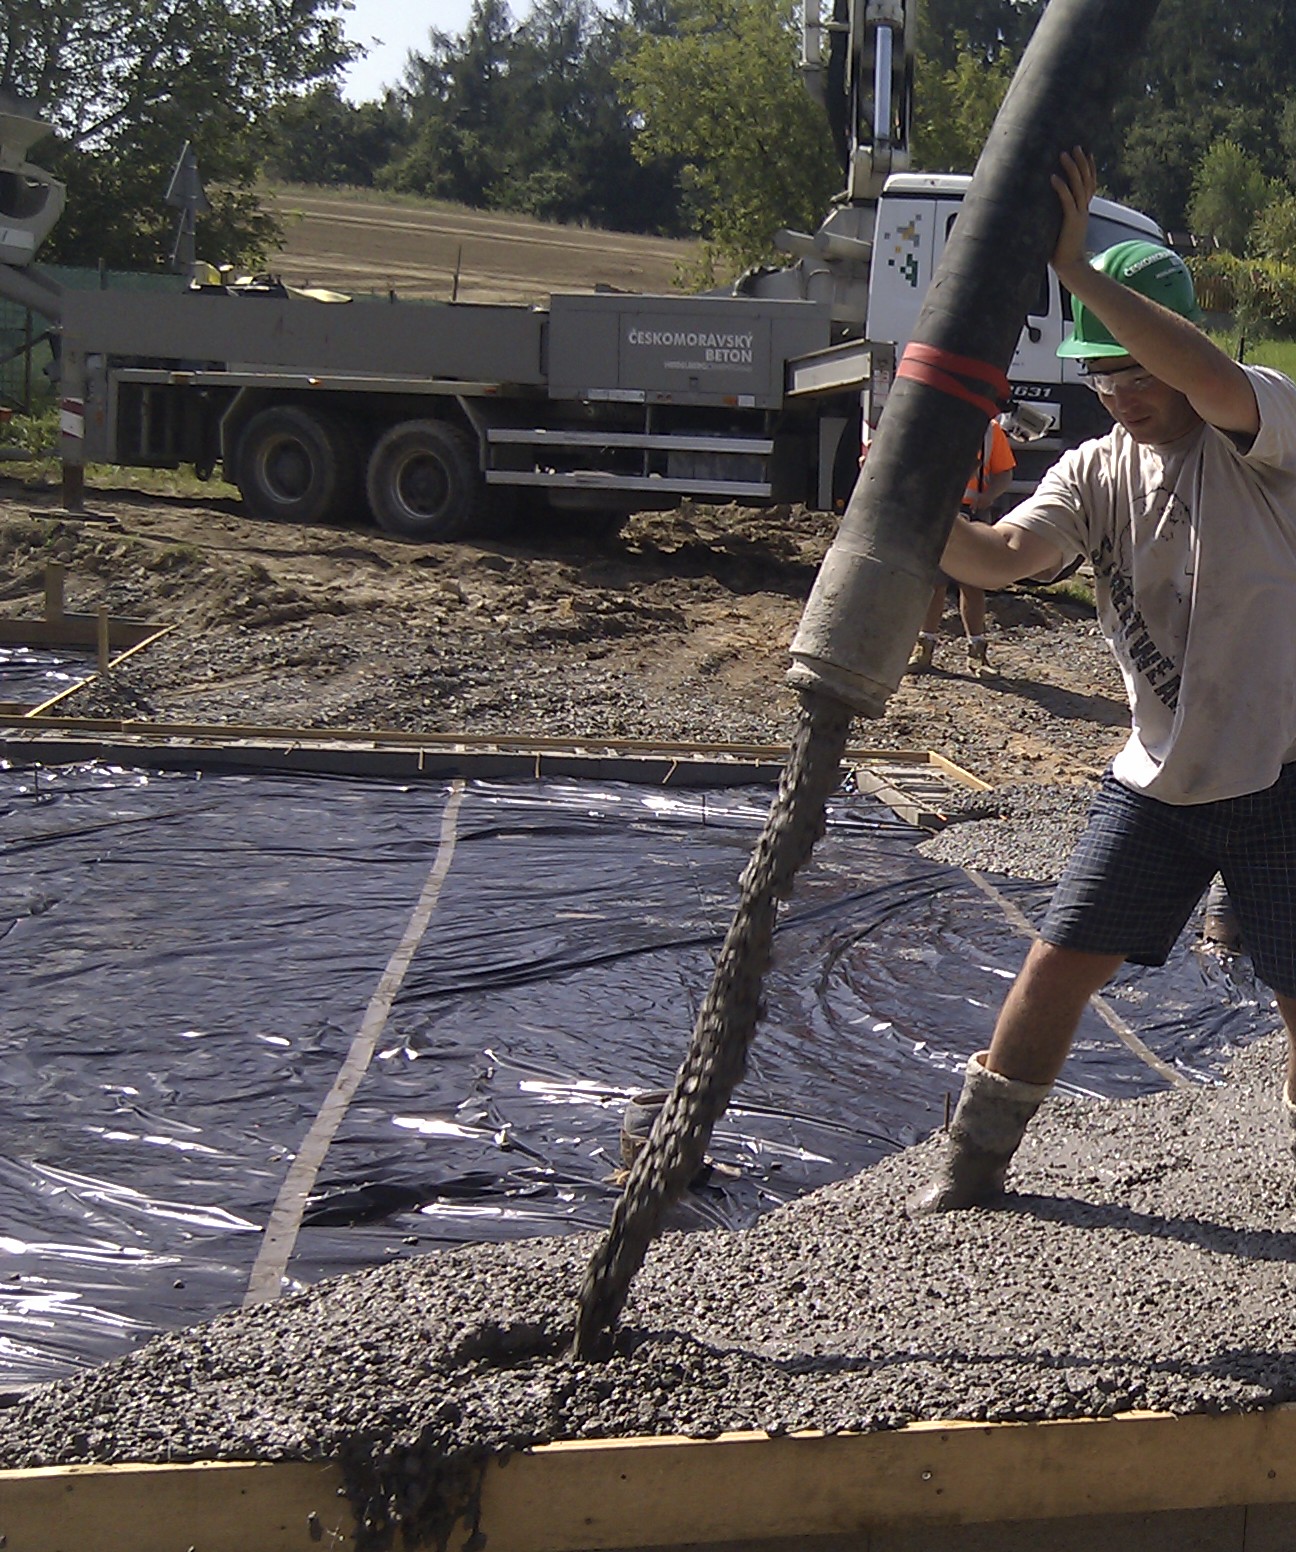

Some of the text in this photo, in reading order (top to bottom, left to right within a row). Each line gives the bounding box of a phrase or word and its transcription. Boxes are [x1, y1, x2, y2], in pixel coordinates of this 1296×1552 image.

[628, 327, 753, 348] ČESKOMORAVSKÝ
[705, 349, 753, 363] BETON
[1010, 385, 1052, 398] 631
